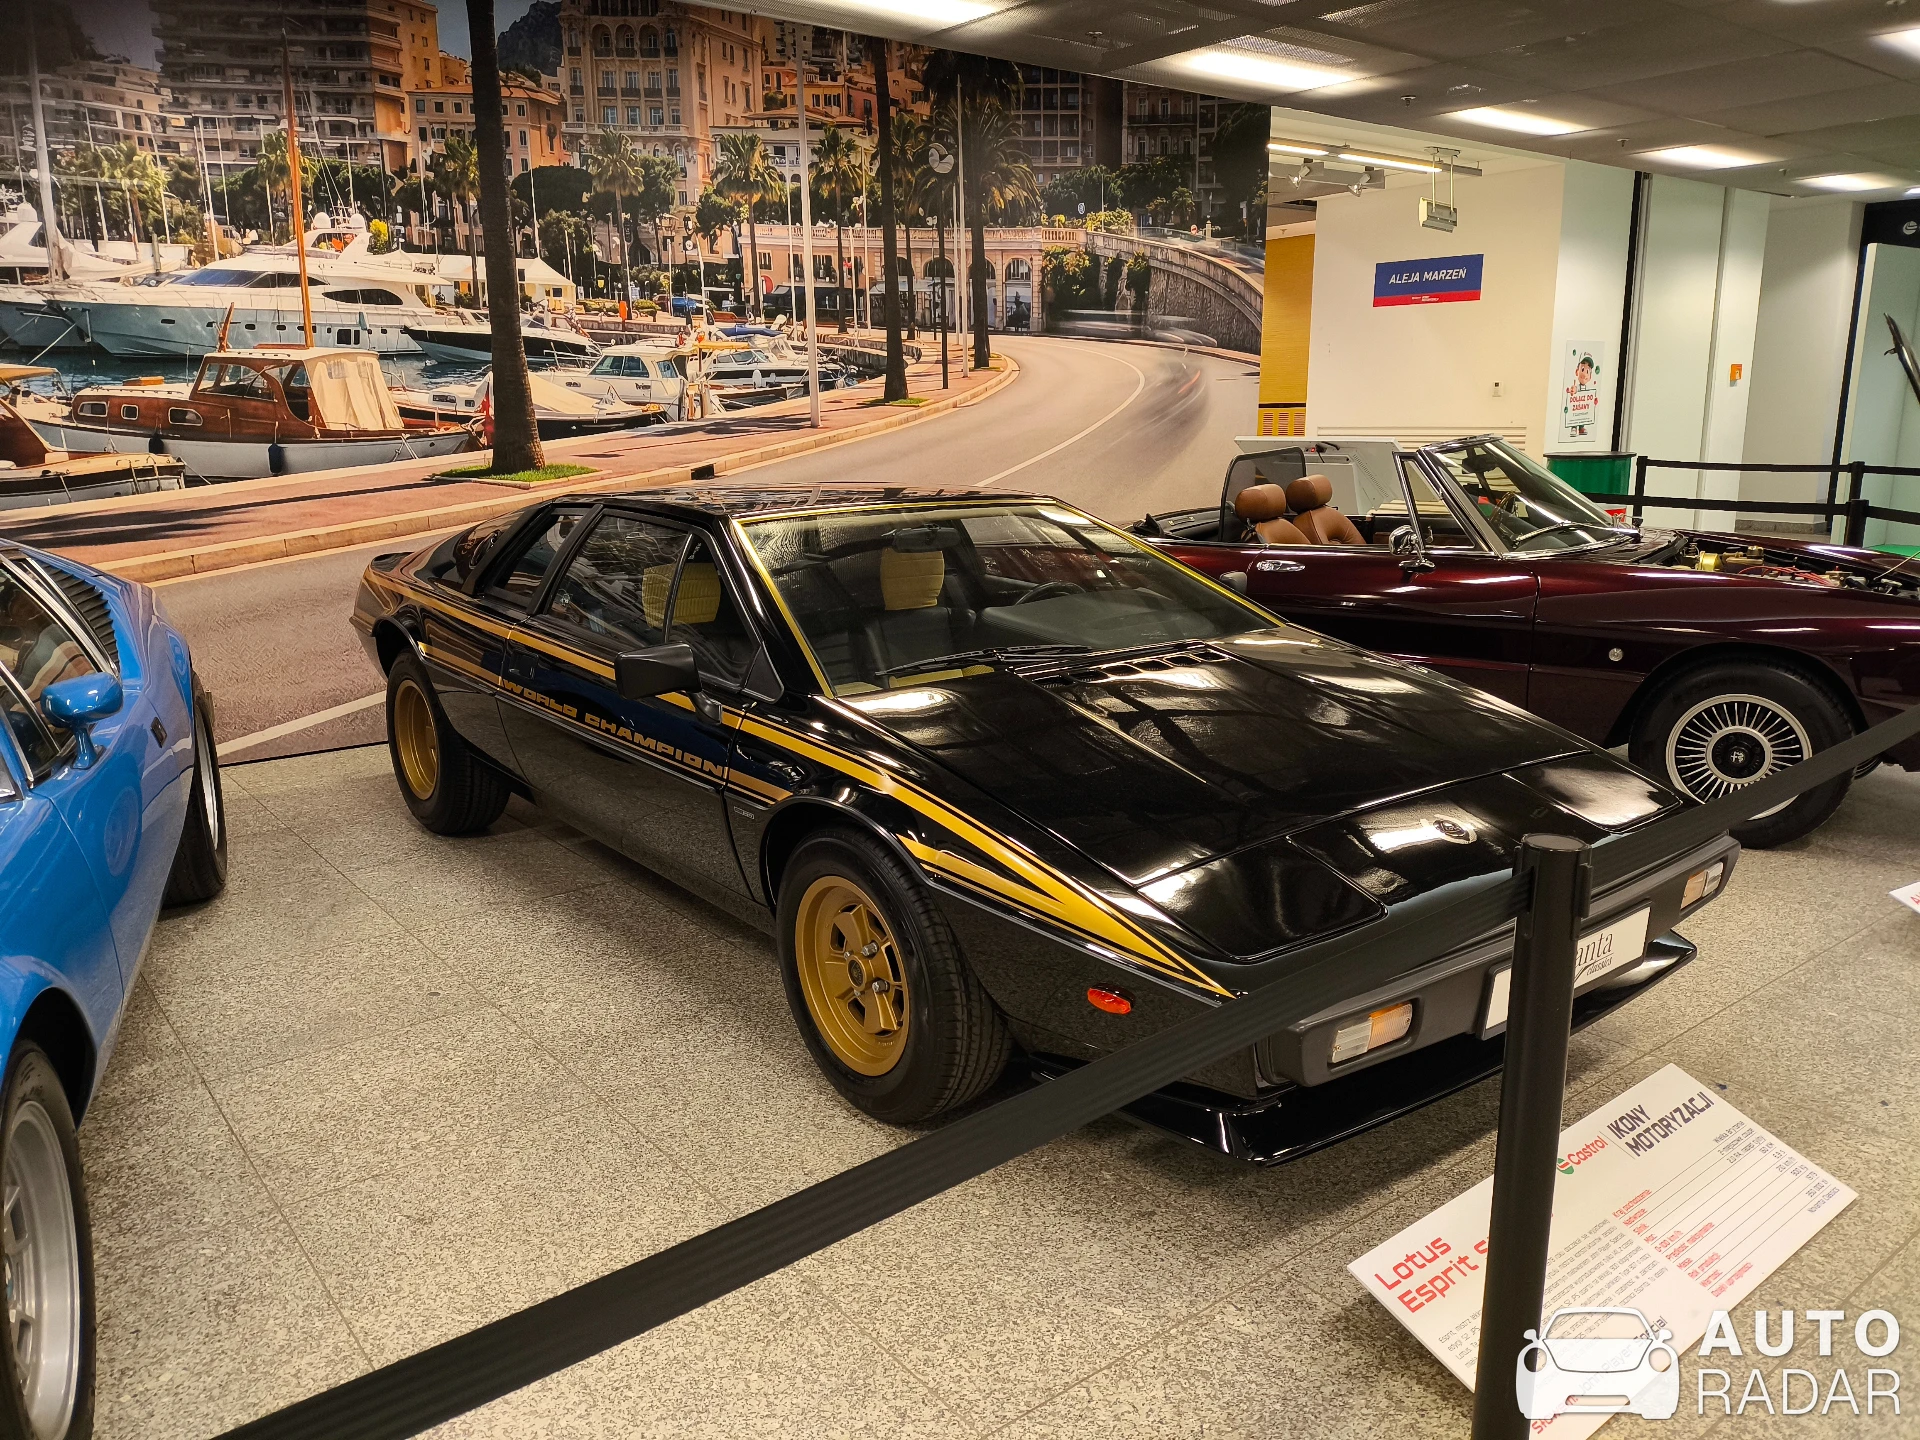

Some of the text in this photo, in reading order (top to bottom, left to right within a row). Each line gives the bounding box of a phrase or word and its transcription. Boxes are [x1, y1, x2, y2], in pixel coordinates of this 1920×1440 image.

[1388, 266, 1467, 284] ALEJA MARZEŃ
[502, 678, 723, 777] WORLD CHAMPION
[1605, 1103, 1651, 1140] IKONY
[1623, 1090, 1715, 1157] MOTORYZACJI
[1566, 1134, 1608, 1165] Castrol
[1373, 1236, 1452, 1291] Lotus
[1396, 1254, 1479, 1313] Esprit
